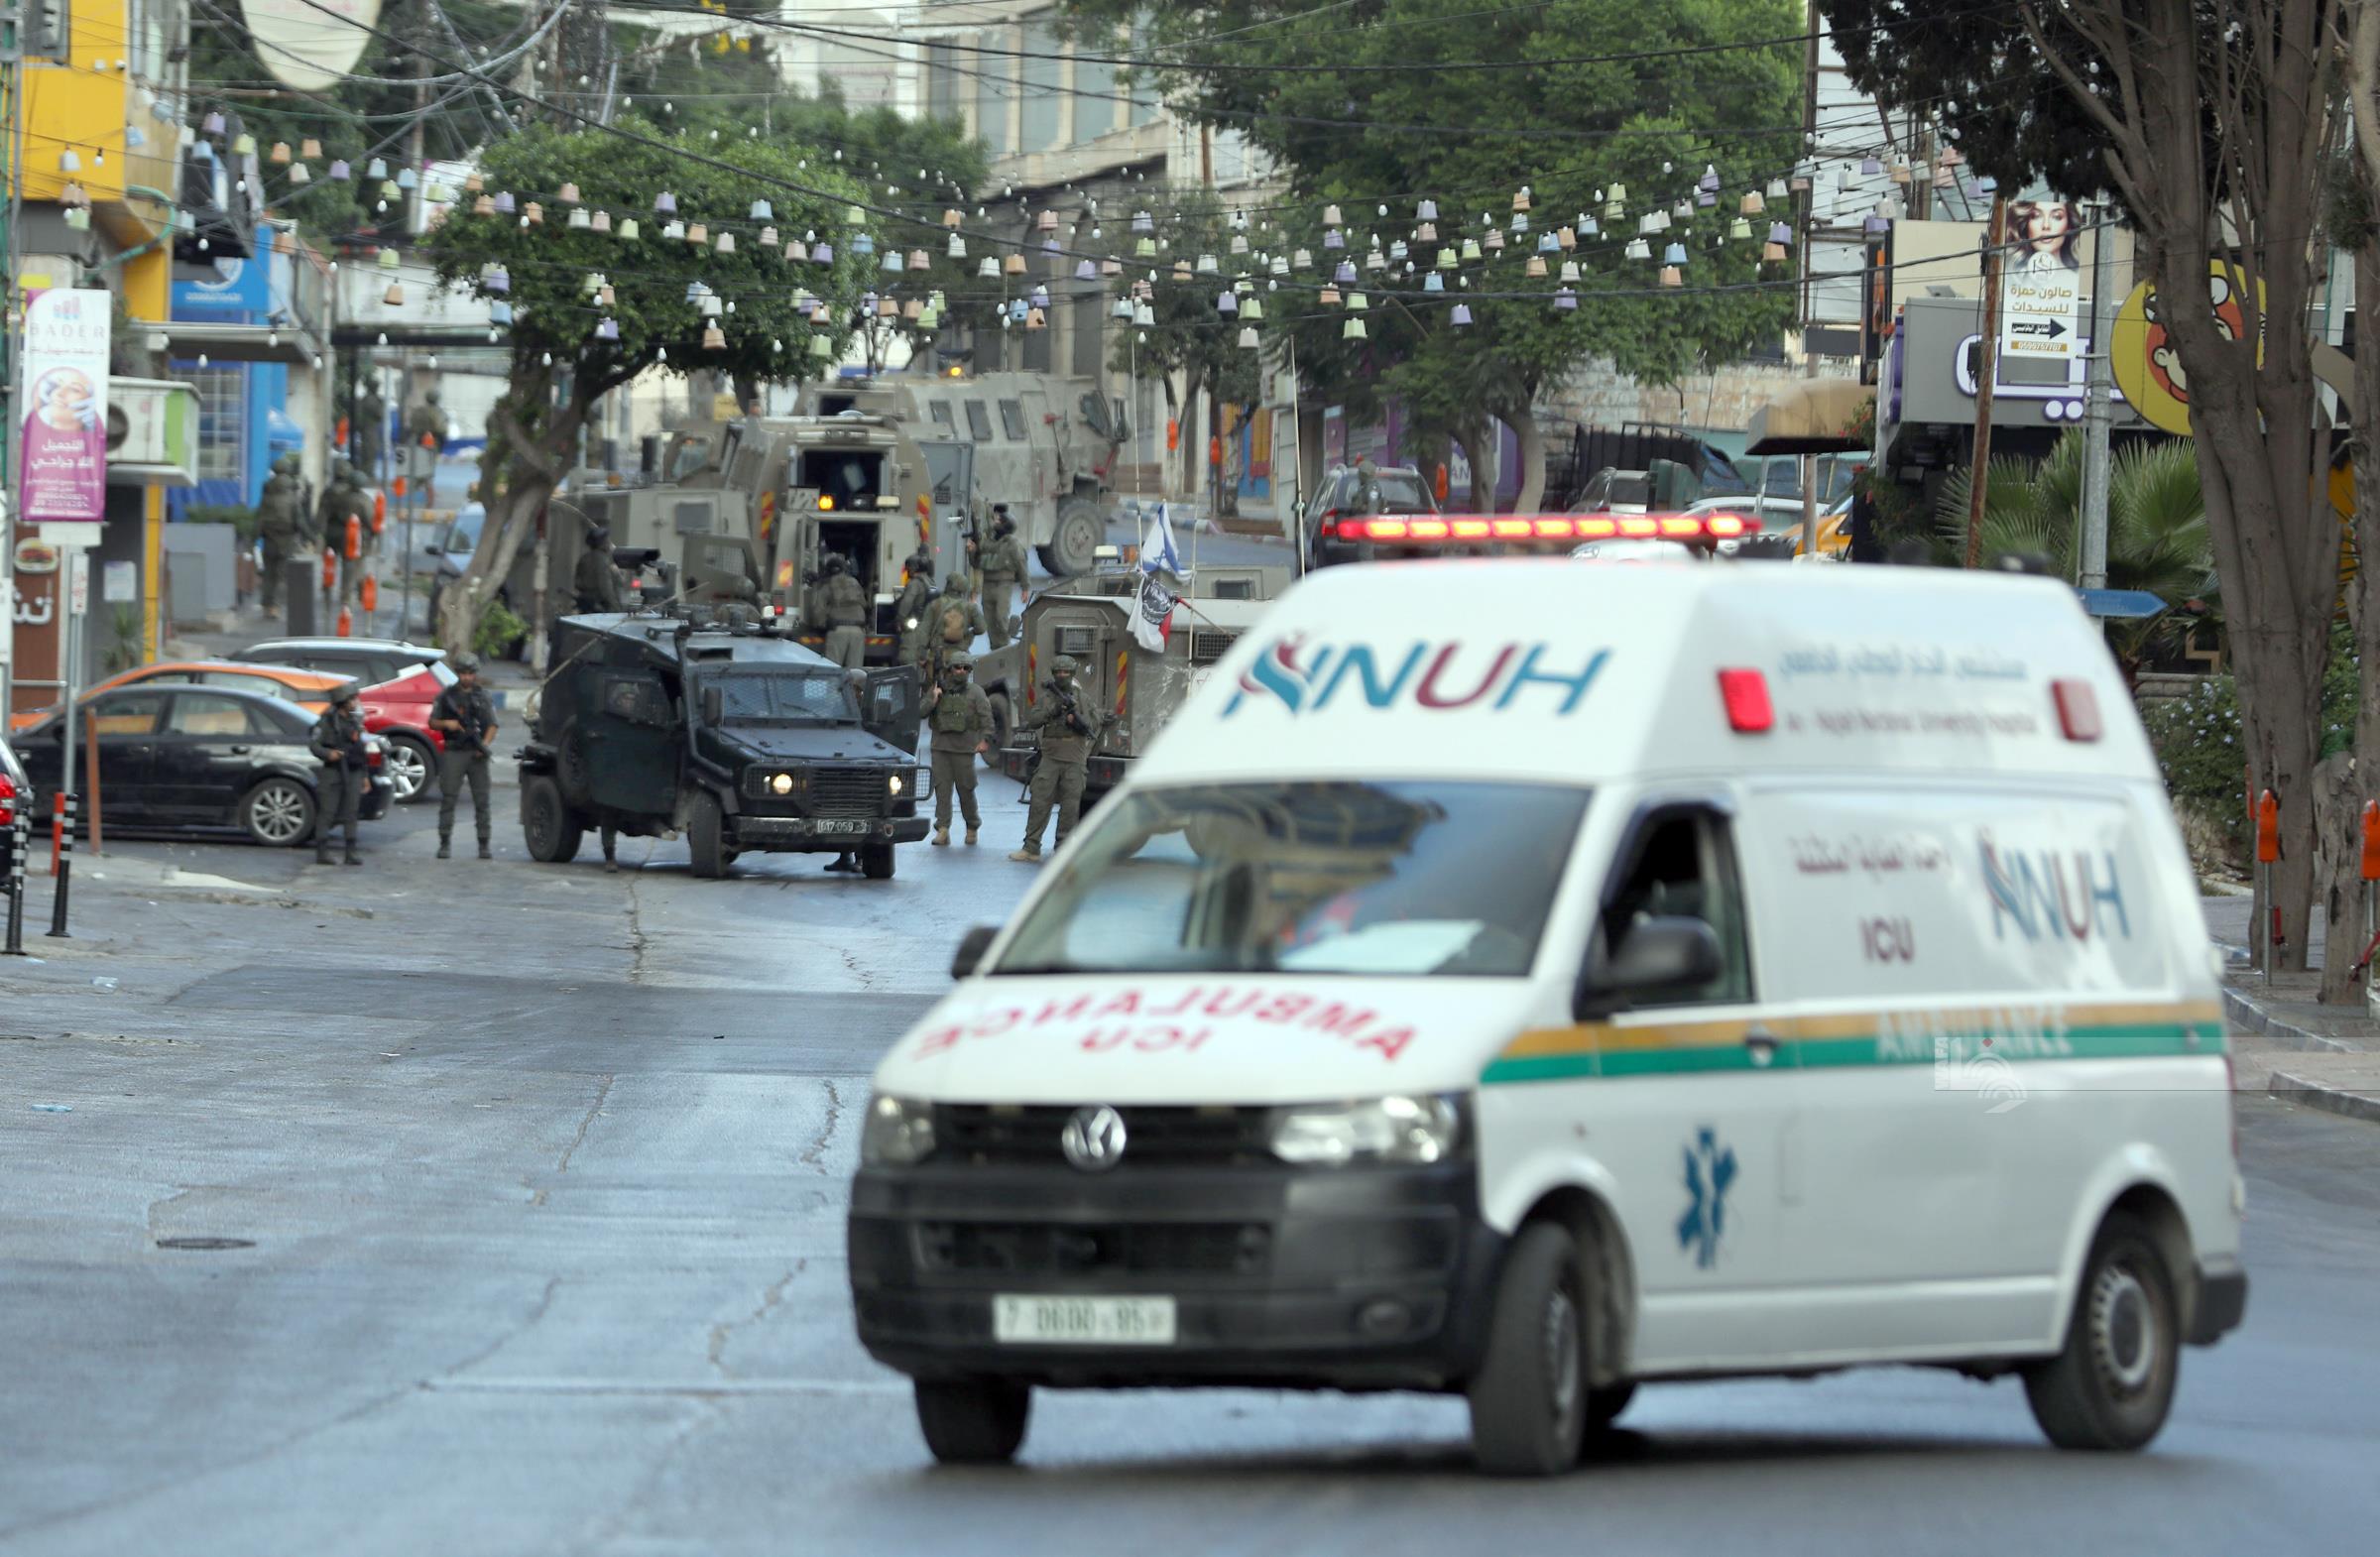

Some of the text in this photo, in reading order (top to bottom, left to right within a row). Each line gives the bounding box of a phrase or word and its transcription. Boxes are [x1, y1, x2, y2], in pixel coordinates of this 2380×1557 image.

[2010, 284, 2073, 299] صالون حمزة
[1857, 915, 1915, 965] ICU
